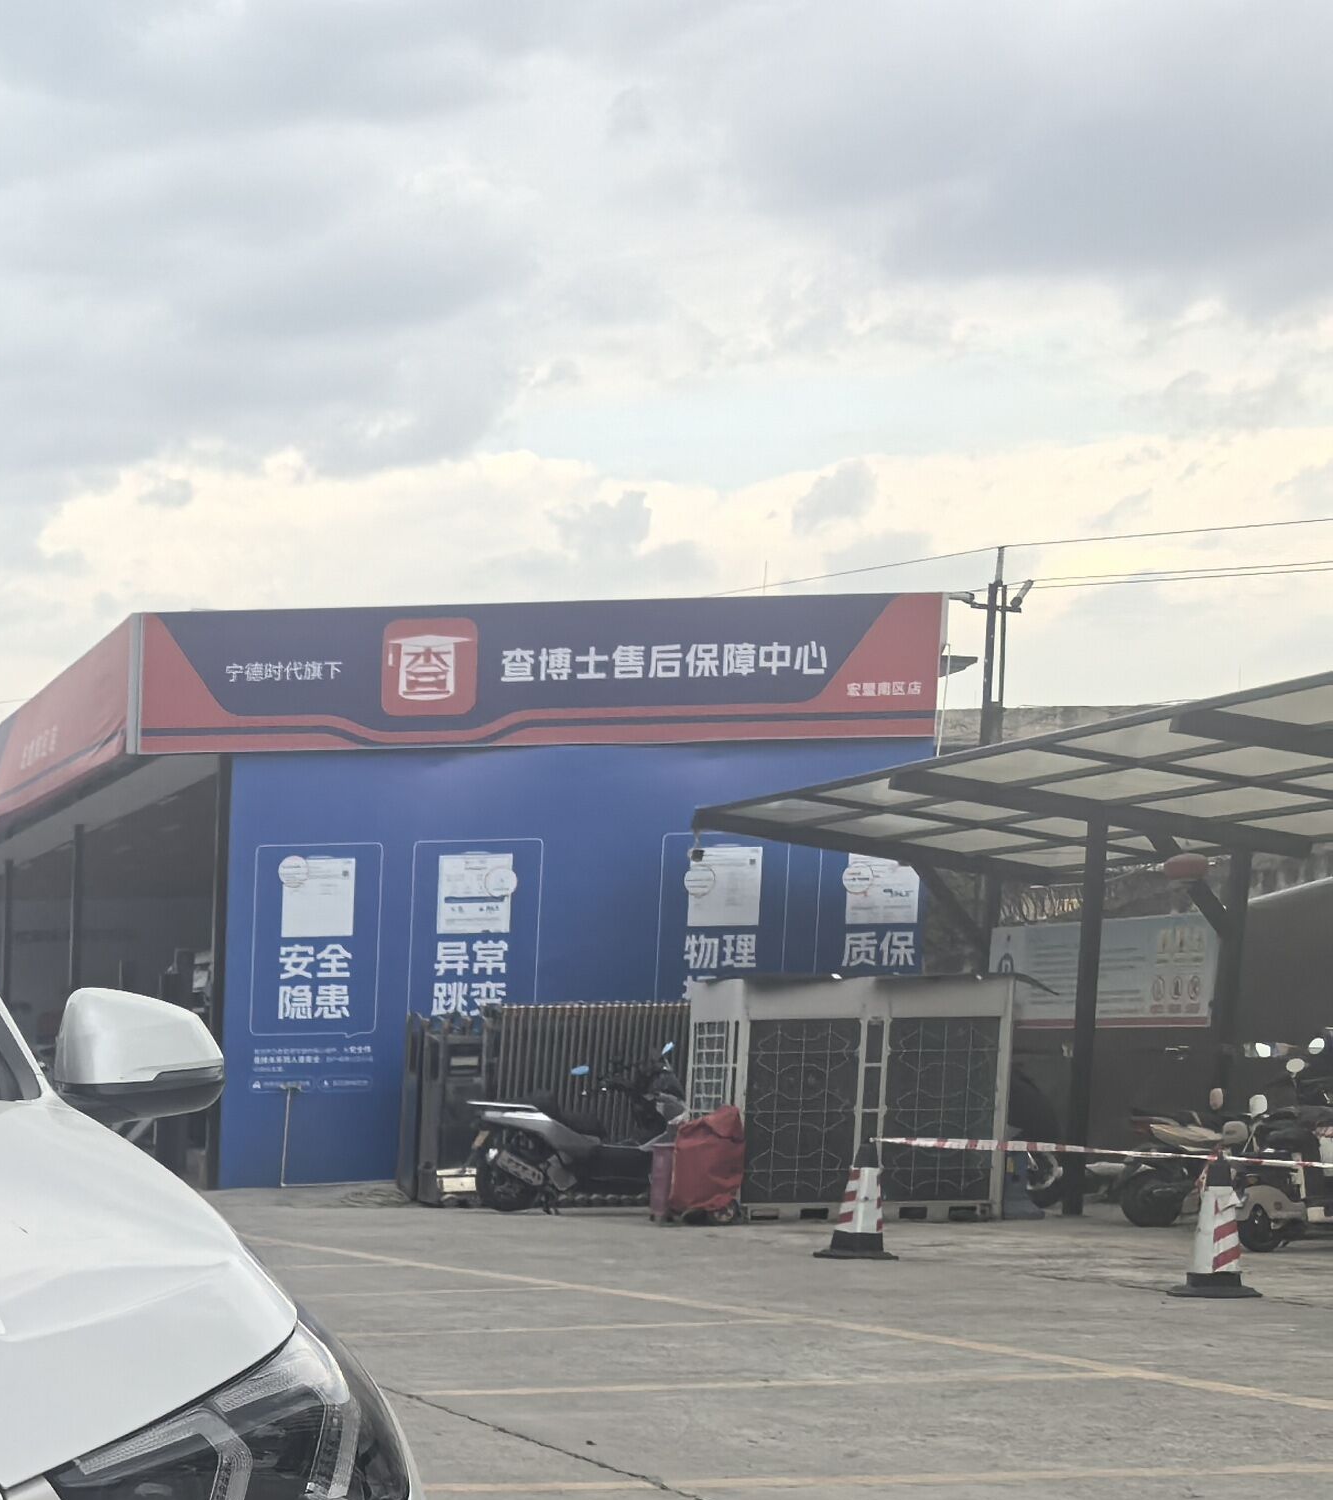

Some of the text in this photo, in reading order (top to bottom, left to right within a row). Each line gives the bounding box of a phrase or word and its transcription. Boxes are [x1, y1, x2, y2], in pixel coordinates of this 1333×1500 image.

[225, 660, 343, 683] 宁德时代旗下
[500, 640, 828, 683] 查博士售后保障中心
[279, 943, 353, 980] 安全
[434, 940, 509, 976] 异常
[683, 934, 757, 970] 物理
[841, 930, 916, 967] 质保
[277, 984, 351, 1020] 隐患
